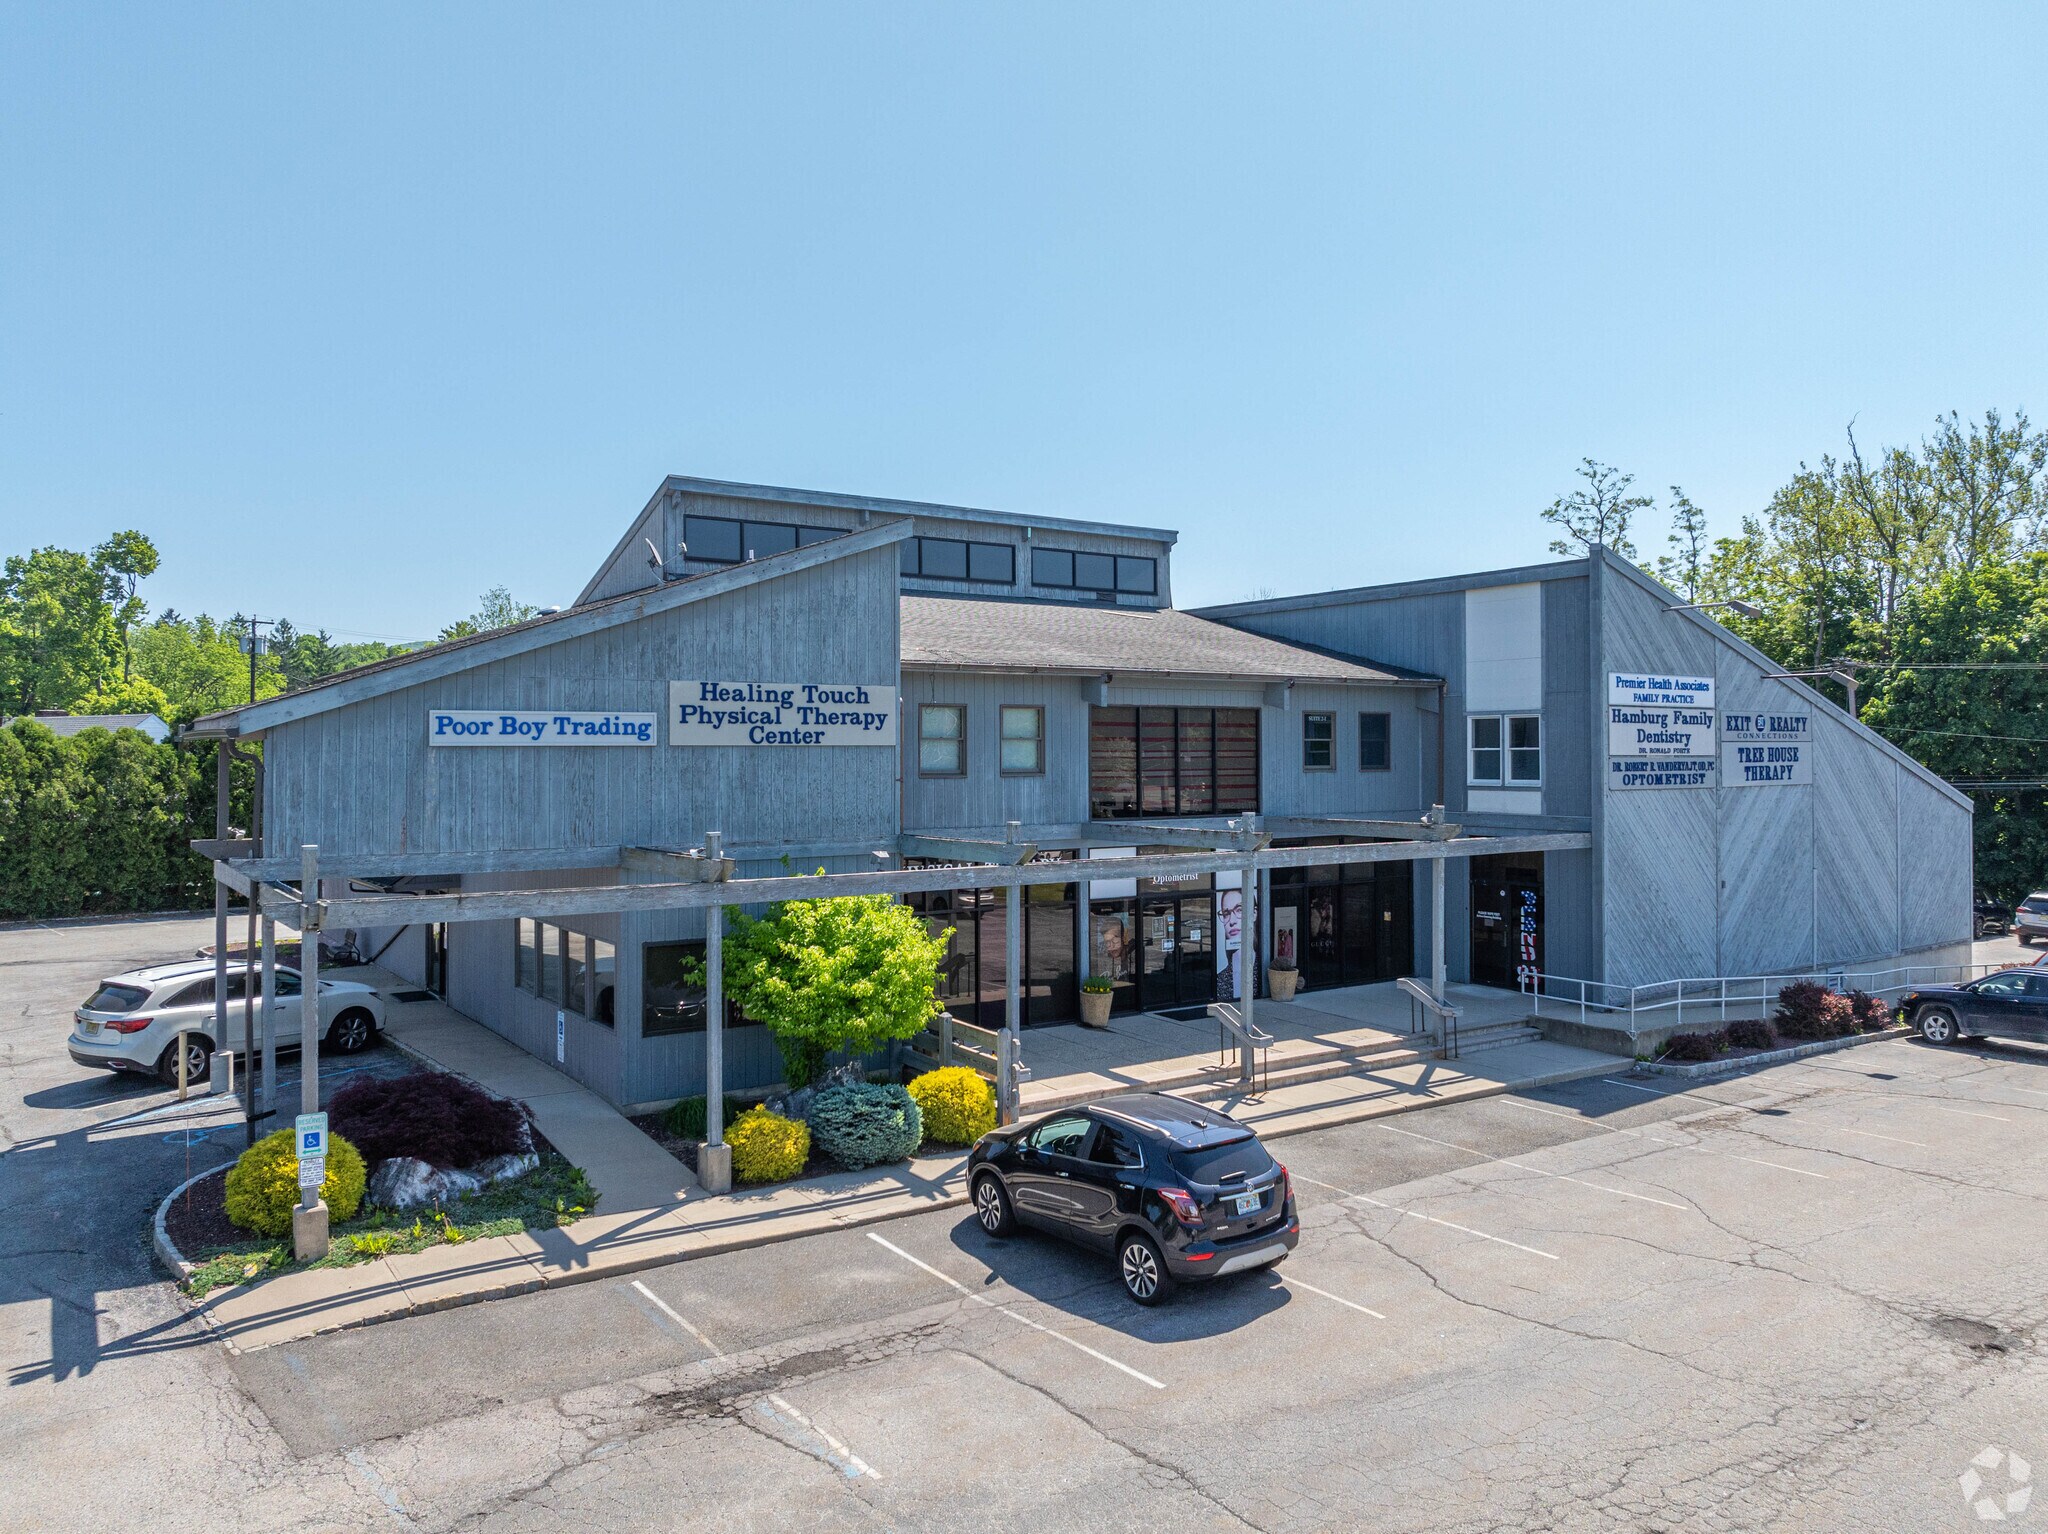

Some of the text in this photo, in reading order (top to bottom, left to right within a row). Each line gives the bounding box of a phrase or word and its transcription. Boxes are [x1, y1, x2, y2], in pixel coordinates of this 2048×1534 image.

[1615, 676, 1710, 692] Premier Health Associates
[700, 682, 870, 709] Healing Touch
[1633, 693, 1694, 704] FAMILY PRACTICE
[679, 705, 888, 730] Physical Therapy
[1611, 708, 1713, 729] Hamburg Family
[1726, 715, 1751, 731] EXIT
[1769, 716, 1808, 732] REALTY
[435, 716, 652, 741] Poor Boy Trading
[748, 726, 825, 744] Center
[1637, 728, 1692, 747] Dentistry
[1737, 747, 1799, 763] TREE HOUSE
[1622, 773, 1706, 785] OPTOMETRIST
[1744, 765, 1794, 781] THERAPY
[1152, 872, 1199, 885] Optometrist
